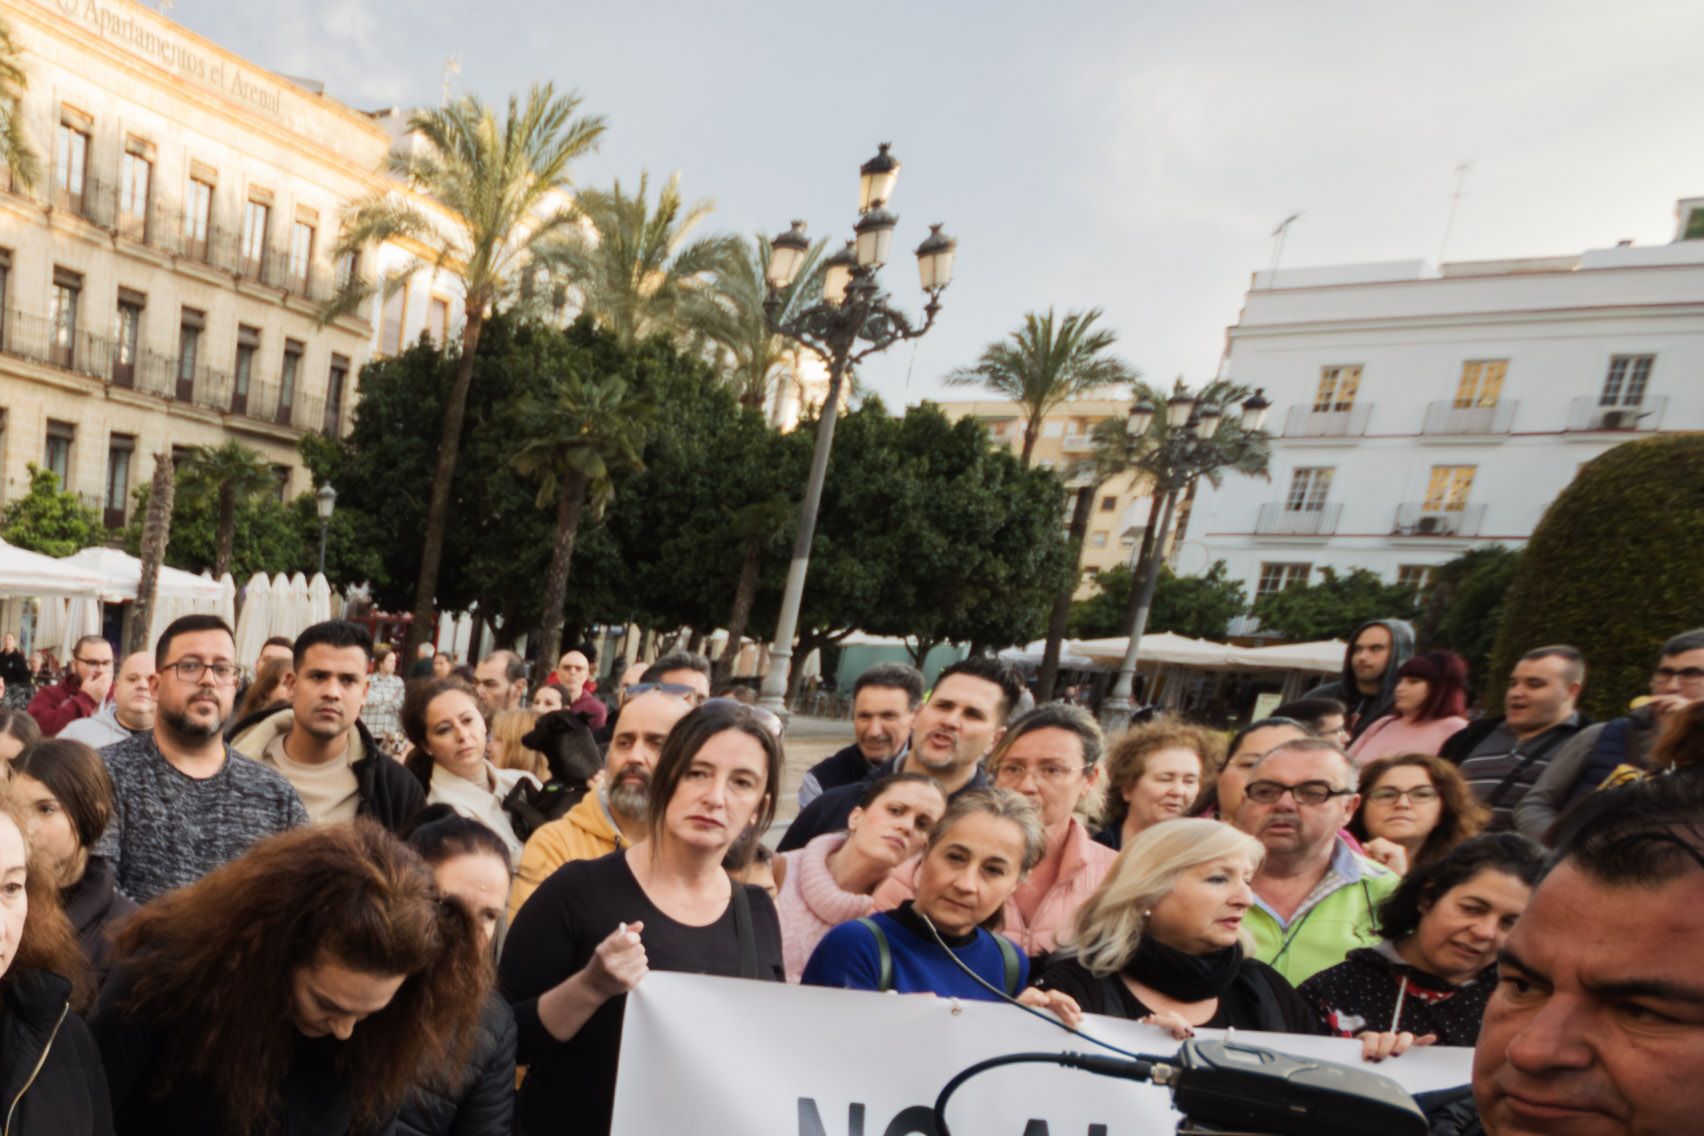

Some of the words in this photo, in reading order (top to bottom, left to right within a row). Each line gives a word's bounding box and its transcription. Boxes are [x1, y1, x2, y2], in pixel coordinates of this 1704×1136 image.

[83, 0, 205, 79] Apartamentos
[210, 62, 225, 88] el
[231, 69, 280, 114] Arenal
